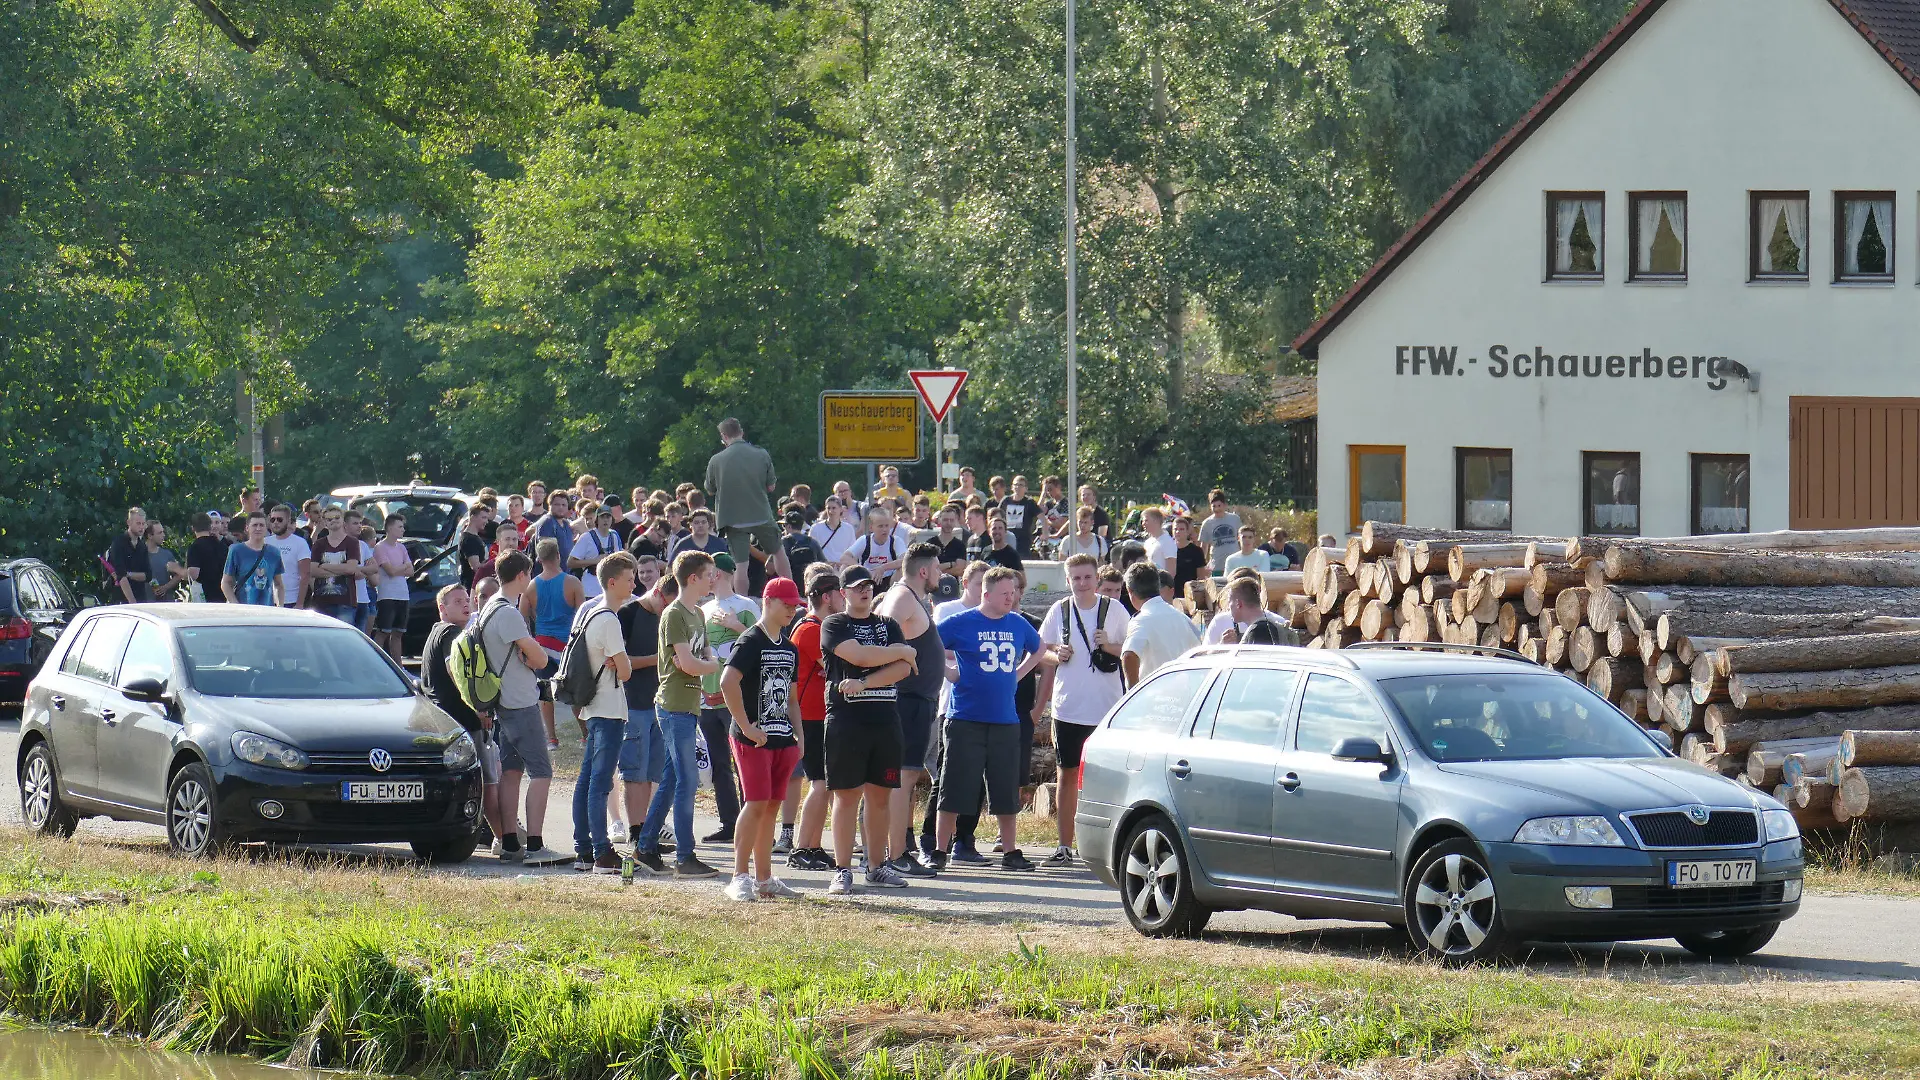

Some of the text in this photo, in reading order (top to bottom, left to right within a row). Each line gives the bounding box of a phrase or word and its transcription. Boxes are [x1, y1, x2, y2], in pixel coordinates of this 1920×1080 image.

[1488, 344, 1728, 390] Schauerberg
[830, 402, 913, 422] Neuschauerberg
[834, 423, 856, 432] Markt
[977, 631, 1014, 641] POLK HIGH
[979, 641, 1016, 673] 33
[350, 782, 369, 798] FÜ
[377, 784, 395, 798] EM
[398, 784, 422, 798] 870
[1680, 864, 1699, 881] FO
[1713, 863, 1731, 881] TO
[1736, 862, 1753, 879] 77
